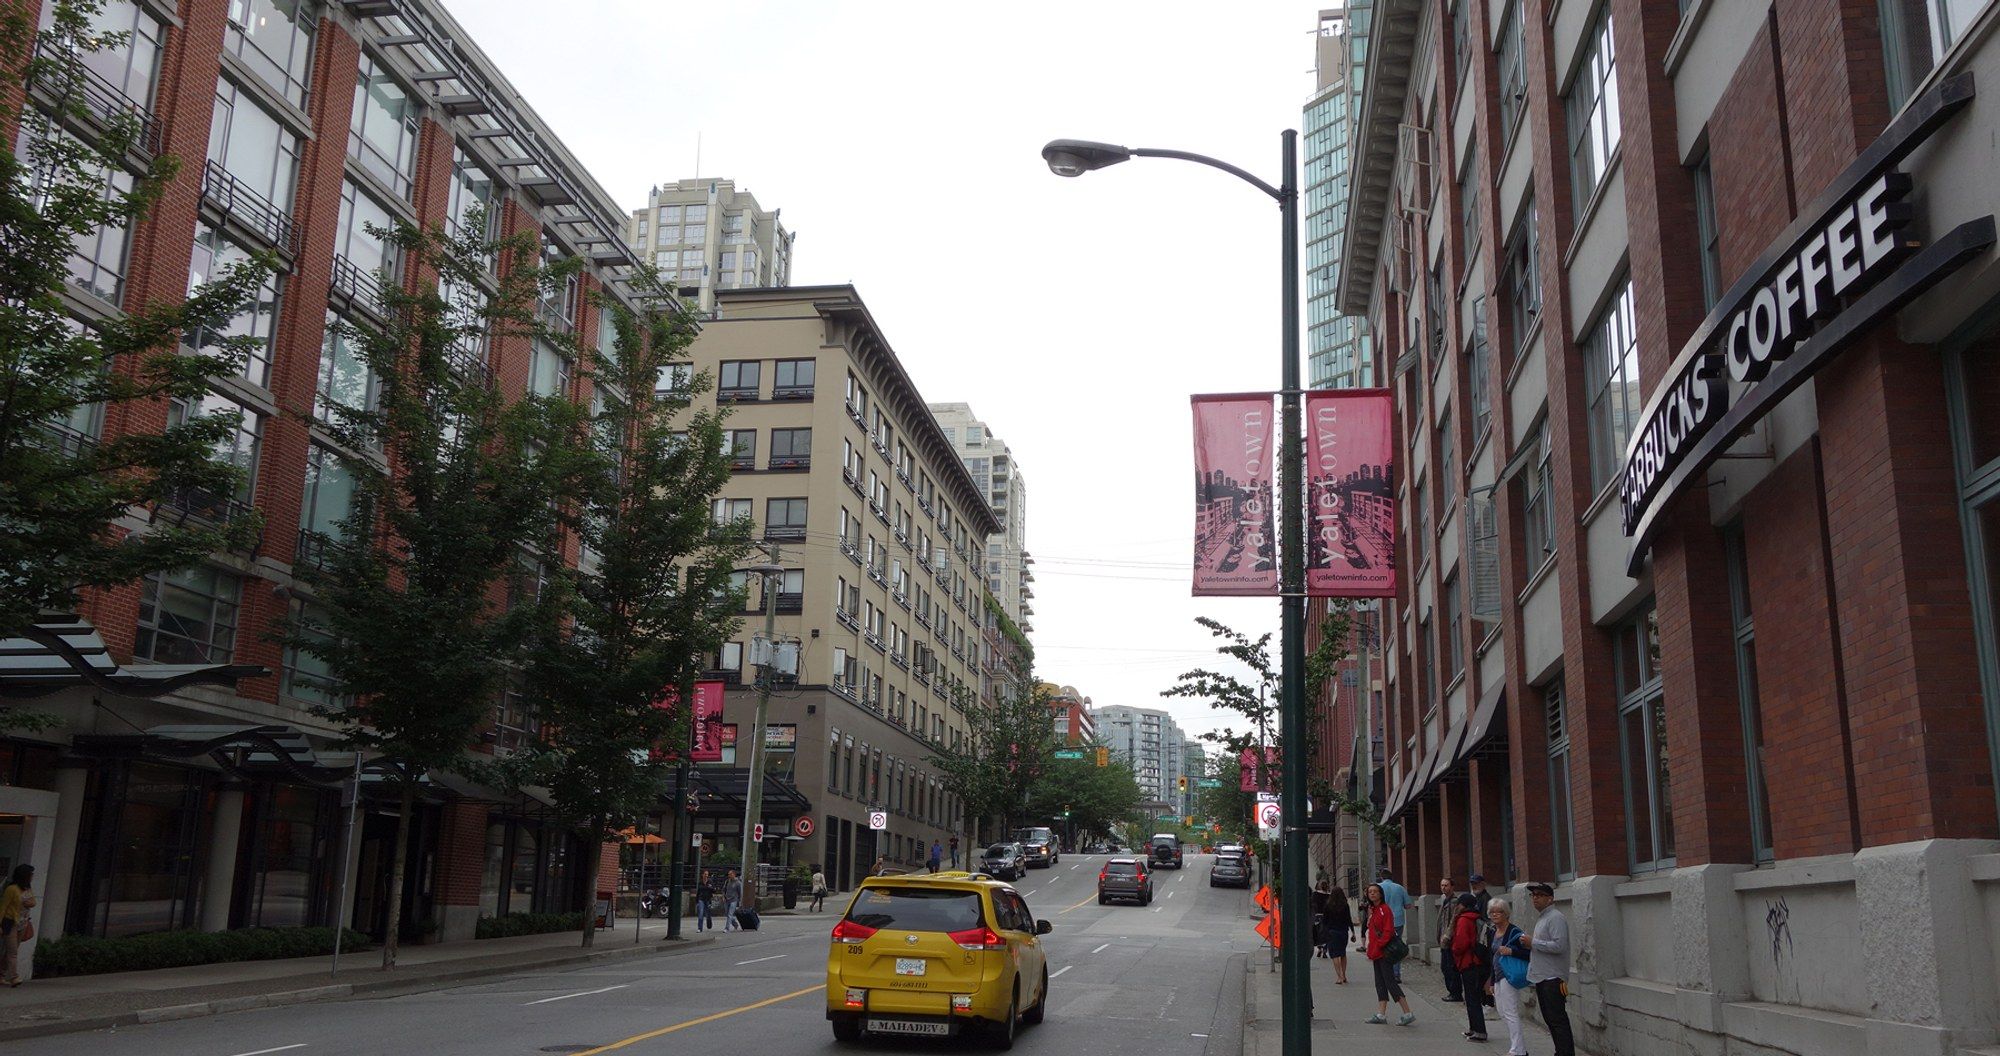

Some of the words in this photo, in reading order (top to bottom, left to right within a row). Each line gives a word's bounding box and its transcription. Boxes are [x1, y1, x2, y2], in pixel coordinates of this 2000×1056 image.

[1620, 354, 1710, 536] STARBUCKS
[1728, 174, 1895, 383] COFFEE
[1239, 410, 1270, 569] yaletown
[1315, 406, 1346, 565] yaletown
[1200, 575, 1269, 584] yaletowninfo.com
[1316, 573, 1388, 583] yaletowninfo.com
[848, 945, 863, 954] 209
[877, 1020, 939, 1033] MAHADEV
